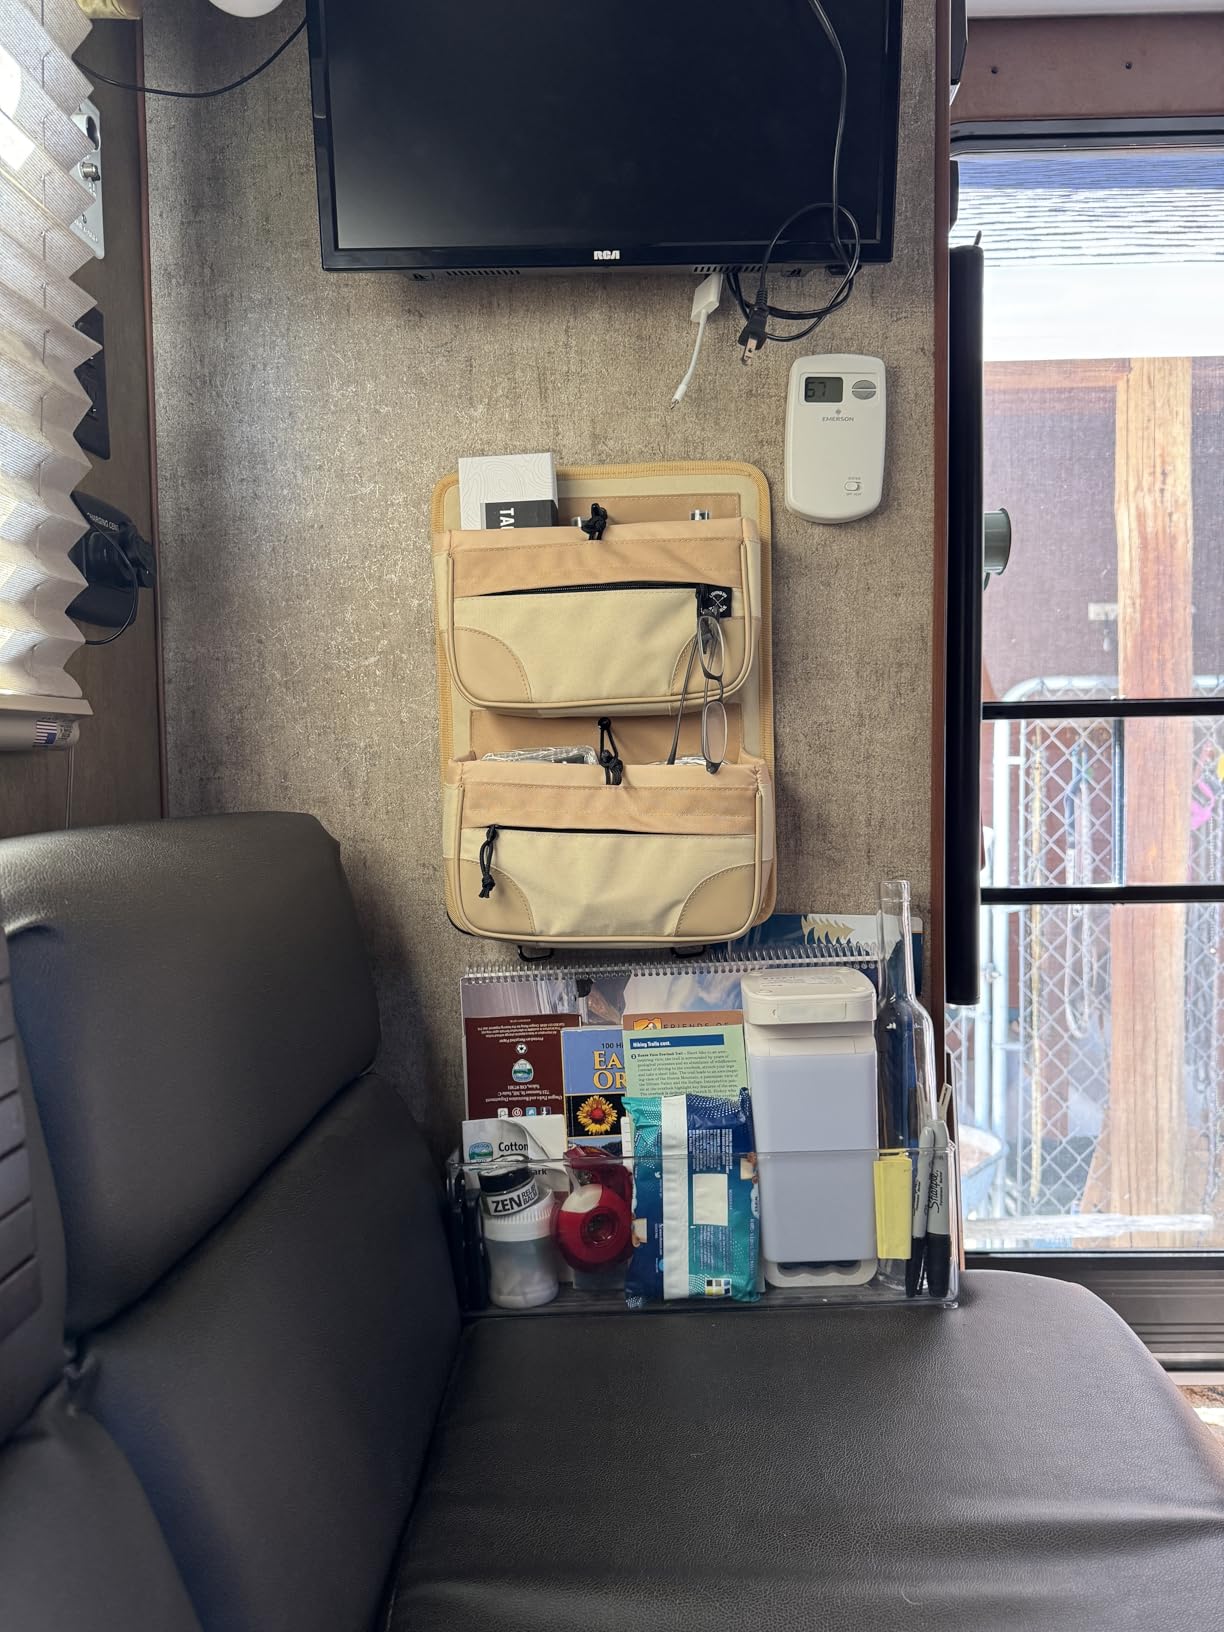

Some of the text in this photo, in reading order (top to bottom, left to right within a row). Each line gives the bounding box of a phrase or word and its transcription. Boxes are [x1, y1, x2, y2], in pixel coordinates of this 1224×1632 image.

[594, 250, 620, 260] RCA
[500, 508, 514, 528] TA
[593, 1050, 624, 1070] EA
[492, 1194, 522, 1213] ZEN
